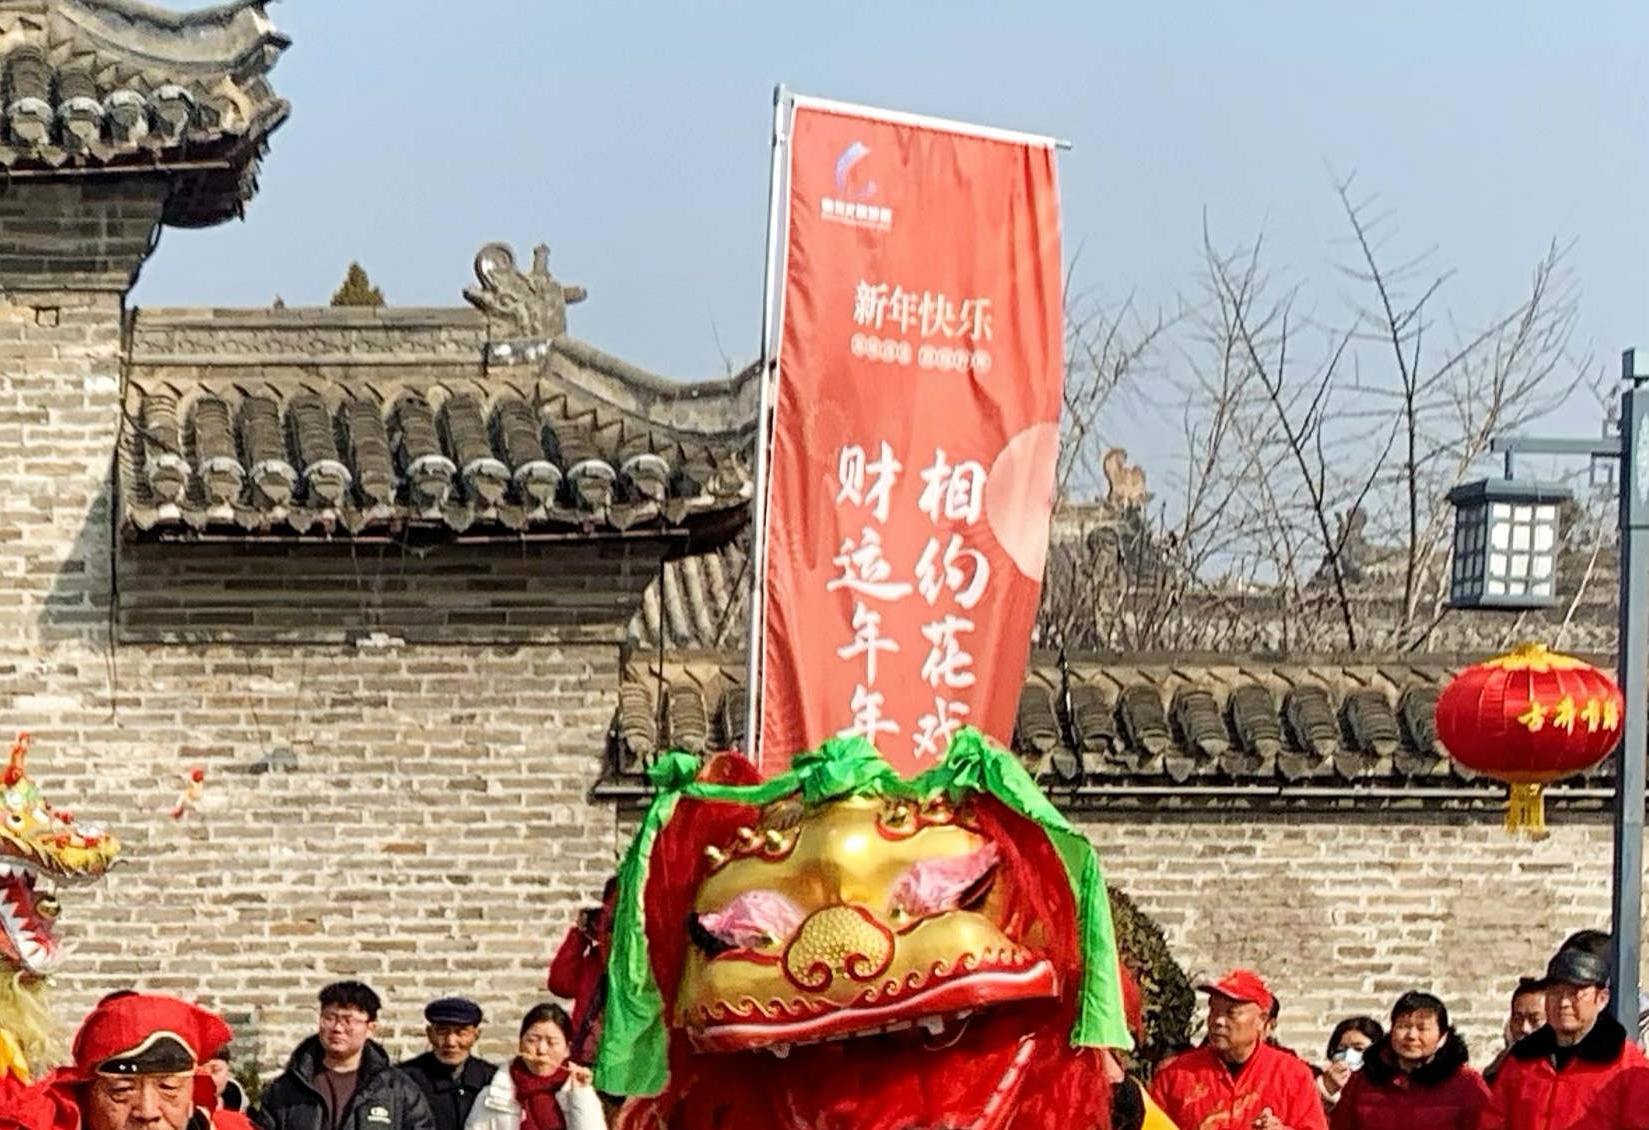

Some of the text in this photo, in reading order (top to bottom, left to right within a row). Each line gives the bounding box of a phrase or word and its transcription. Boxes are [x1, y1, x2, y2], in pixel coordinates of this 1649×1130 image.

[852, 278, 994, 342] 新年快乐
[826, 439, 914, 744] 财运年年
[913, 447, 991, 758] 相约花戏
